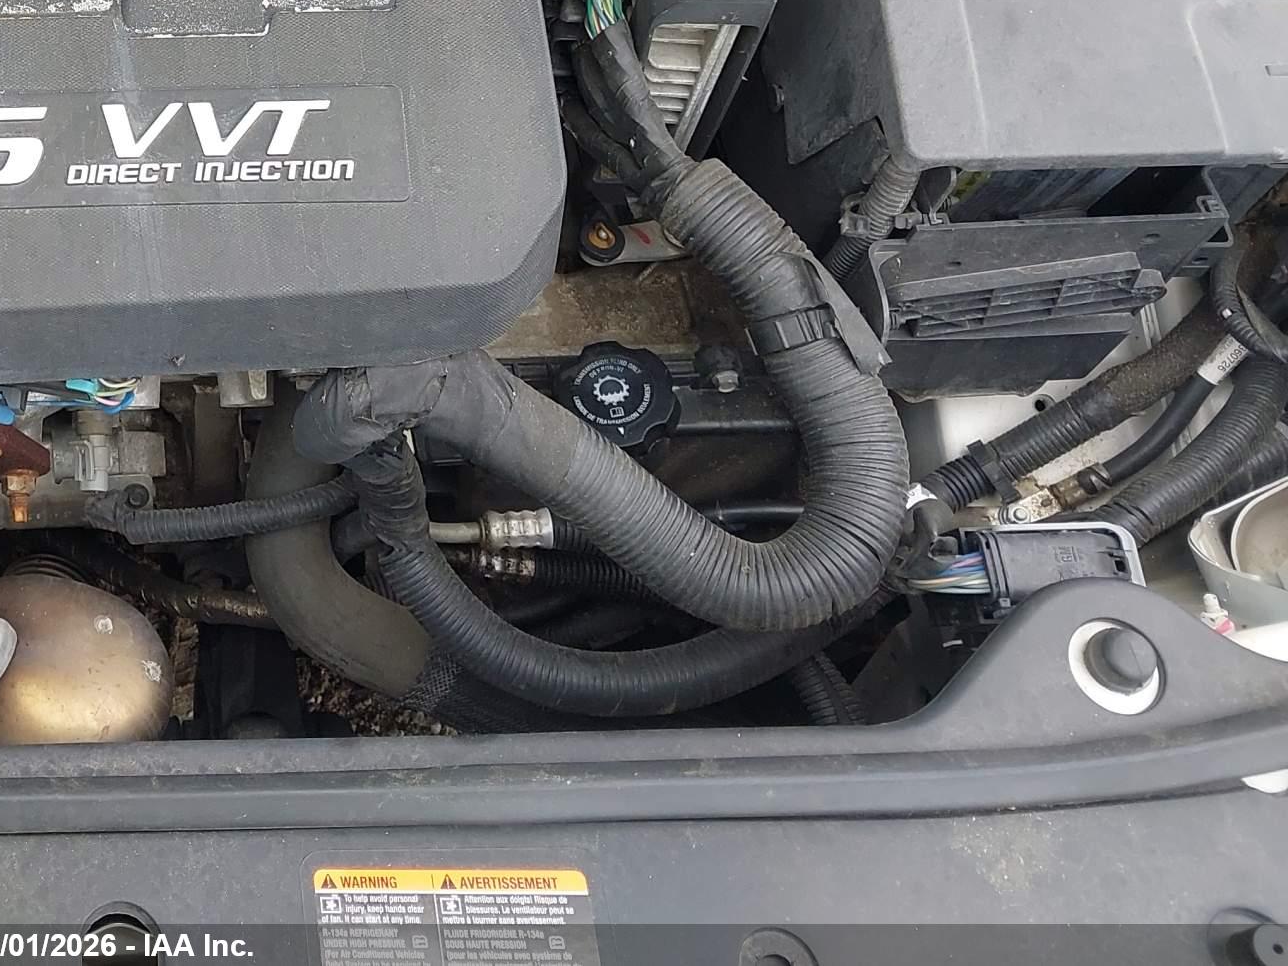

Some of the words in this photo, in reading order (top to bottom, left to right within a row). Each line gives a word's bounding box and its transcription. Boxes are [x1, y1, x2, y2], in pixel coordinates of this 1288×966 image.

[101, 100, 331, 157] VVT
[67, 162, 181, 185] DIRECT
[195, 160, 354, 182] INJECTION
[340, 876, 398, 889] WARNING
[460, 877, 558, 890] AVERTISSEMENT
[344, 894, 352, 902] To
[354, 894, 368, 904] help
[370, 894, 388, 902] avoid
[389, 895, 418, 904] personal
[345, 904, 366, 914] injury,
[368, 904, 384, 914] keep
[385, 905, 406, 913] hands
[408, 905, 424, 914] clear
[322, 915, 329, 923] of
[365, 915, 382, 923] start
[391, 916, 403, 924] any
[404, 915, 422, 924] time.
[323, 939, 348, 948] UNDER
